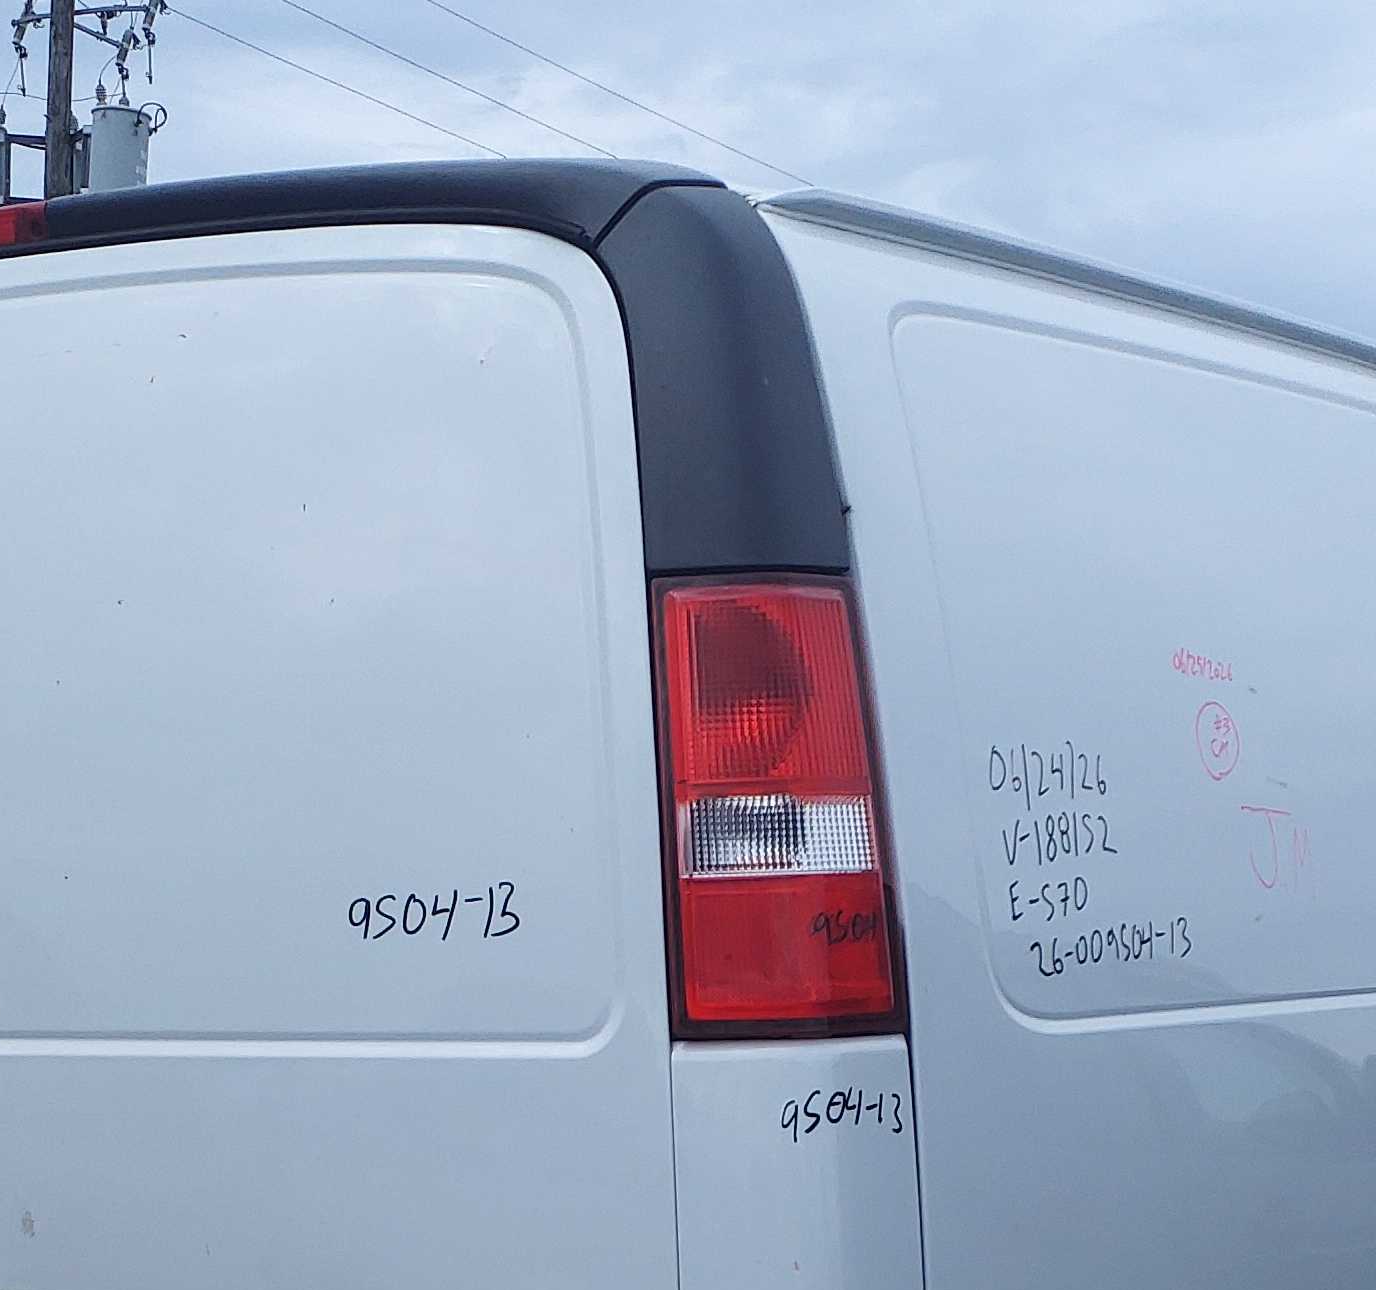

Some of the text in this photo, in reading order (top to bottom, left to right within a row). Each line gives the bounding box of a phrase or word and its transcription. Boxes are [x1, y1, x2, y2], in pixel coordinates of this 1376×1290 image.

[989, 740, 1107, 811] 06/24/26
[1002, 811, 1118, 866] V-188152
[348, 881, 521, 941] 9504-13
[1009, 876, 1088, 922] E-570
[1030, 916, 1192, 977] 26-009504-13
[781, 1086, 903, 1143] 9504-13
